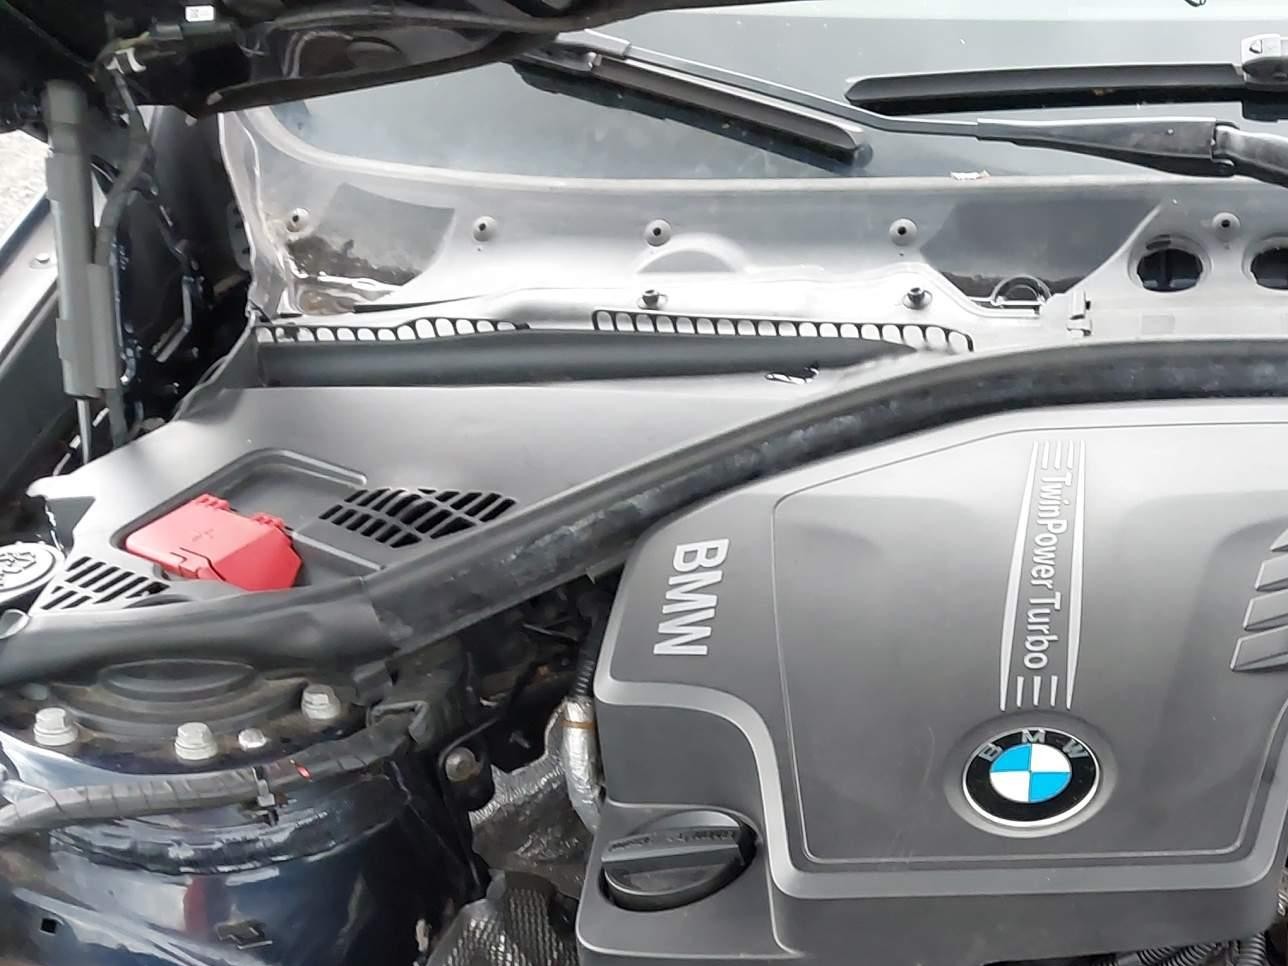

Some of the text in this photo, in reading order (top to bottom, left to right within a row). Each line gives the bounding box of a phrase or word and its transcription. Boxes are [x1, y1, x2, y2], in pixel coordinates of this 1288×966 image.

[653, 538, 729, 655] BMW
[1023, 471, 1073, 670] TwinPower Turbo
[978, 728, 1089, 763] BMW
